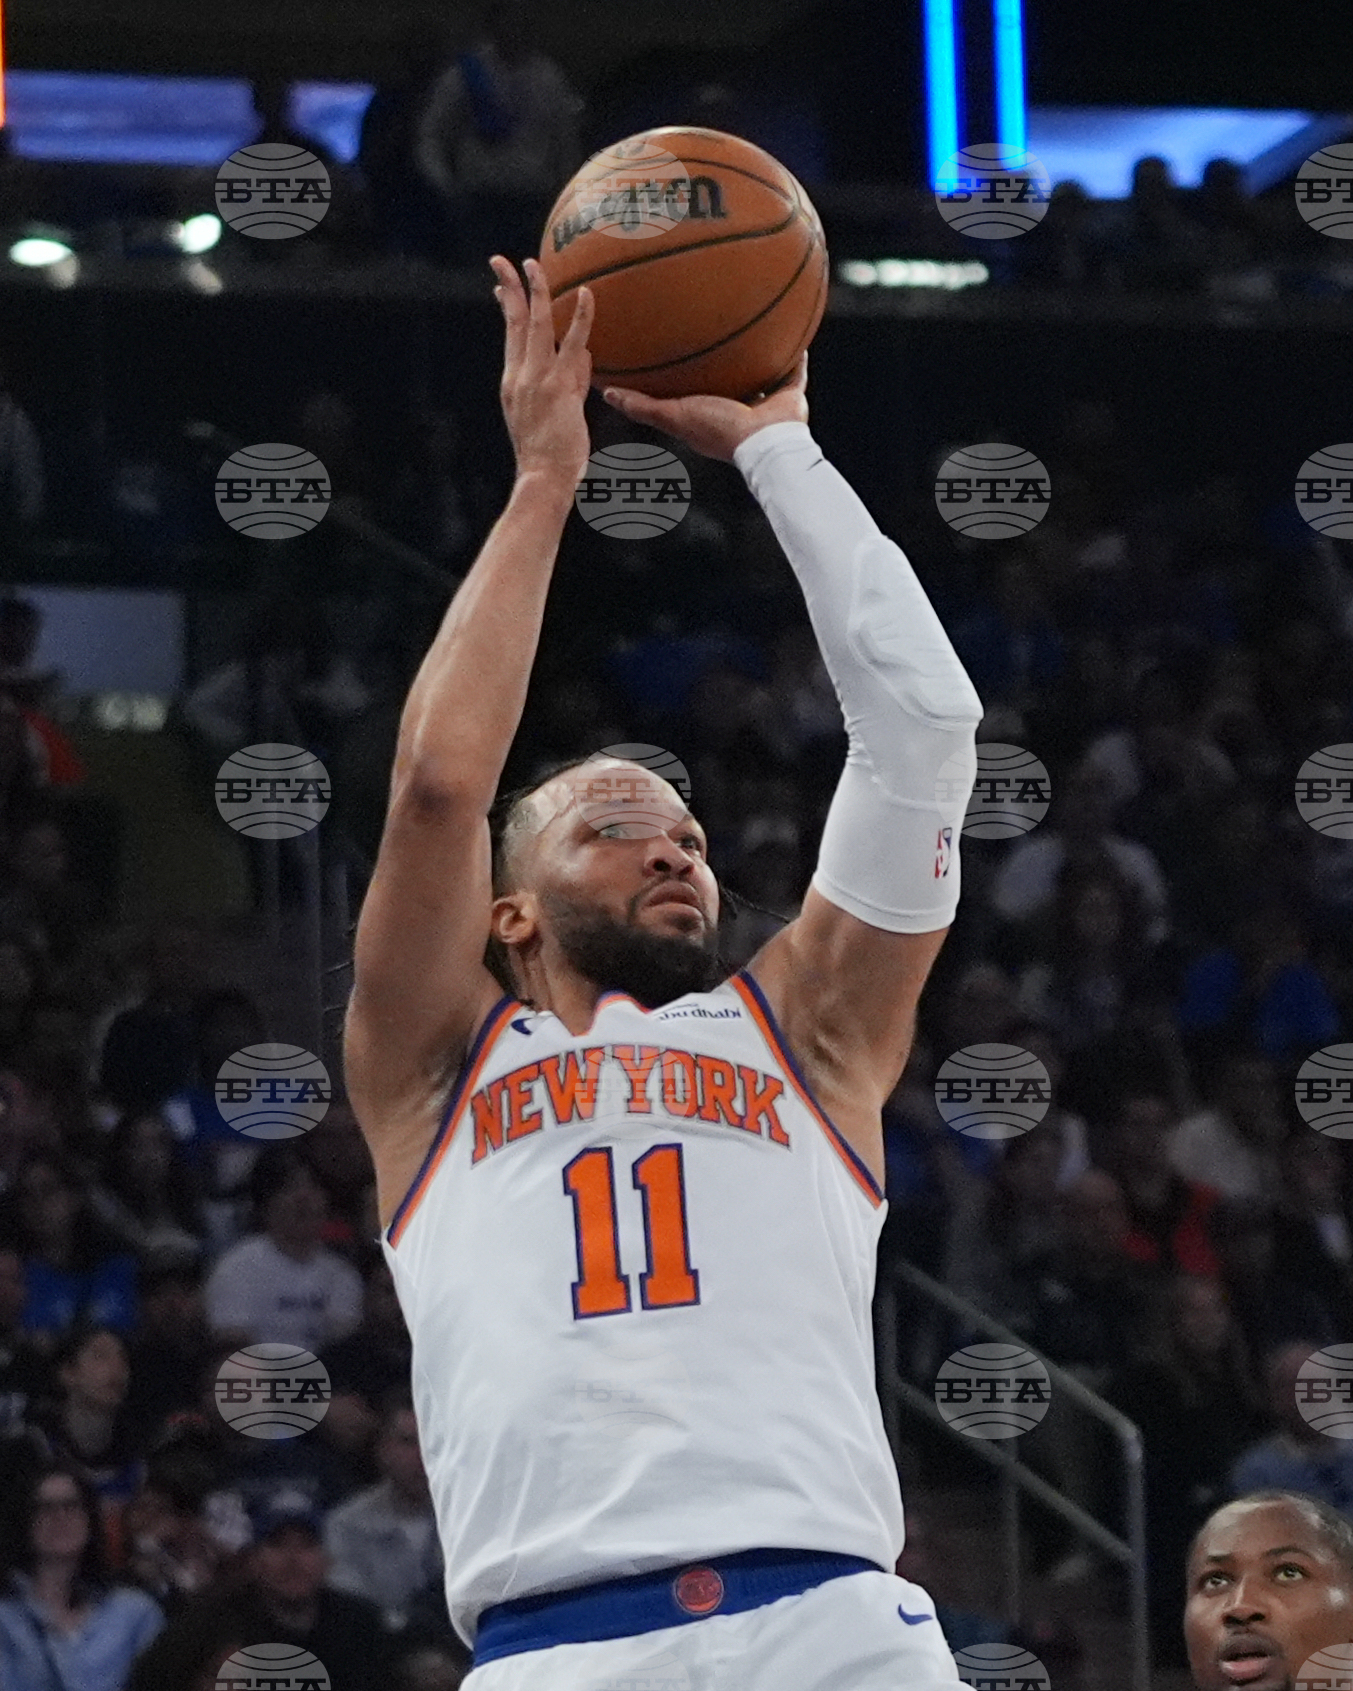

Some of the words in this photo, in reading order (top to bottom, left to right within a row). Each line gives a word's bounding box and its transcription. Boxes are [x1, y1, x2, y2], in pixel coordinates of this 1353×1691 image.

[472, 1045, 606, 1168] NEW
[612, 1044, 792, 1152] YORK
[562, 1143, 701, 1320] 11
